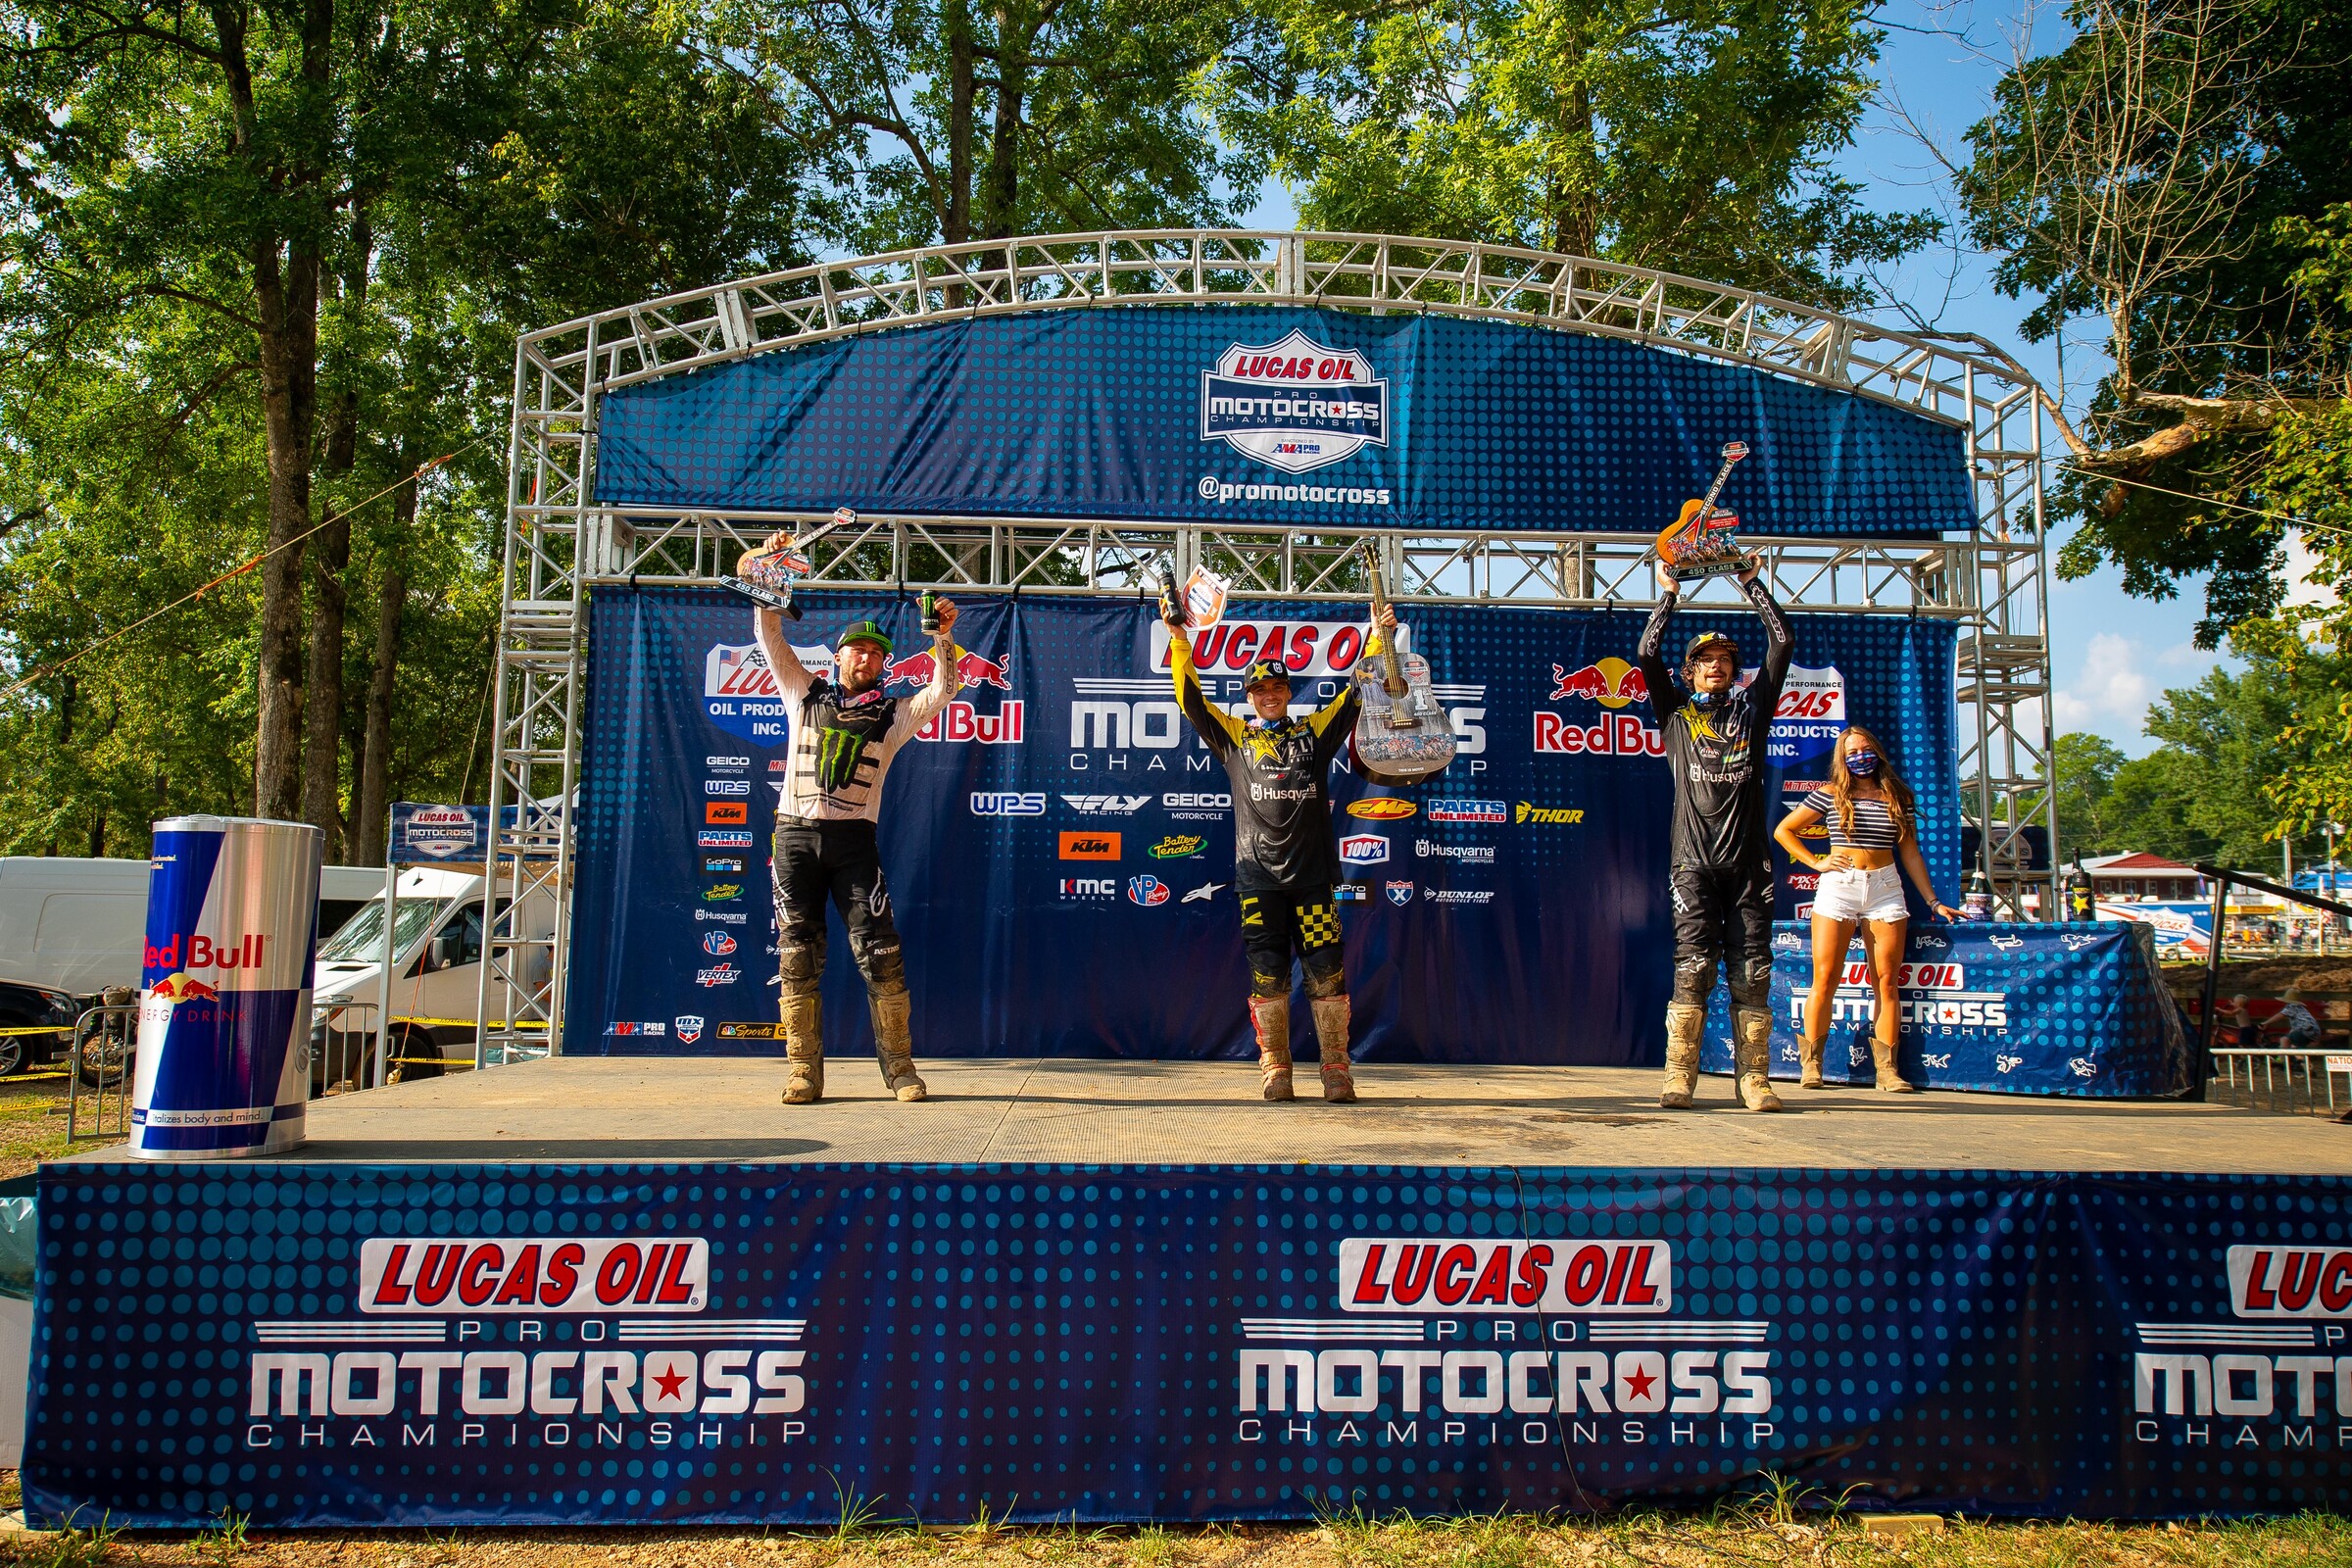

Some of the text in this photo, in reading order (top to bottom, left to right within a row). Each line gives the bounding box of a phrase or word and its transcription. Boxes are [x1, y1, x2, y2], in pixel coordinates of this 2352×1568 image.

[1234, 356, 1355, 380] LUCAS OIL
[1210, 397, 1379, 420] MOTOCROSS
[1210, 416, 1380, 427] CHAMPIONSHIP
[1270, 444, 1303, 454] AMA
[1199, 475, 1390, 505] @promotocross
[1700, 464, 1732, 514] SECOND PLACE
[1708, 564, 1736, 572] CLASS
[735, 582, 775, 602] 450 CLASS
[1227, 680, 1336, 698] PO
[710, 703, 785, 716] OIL PROD
[1773, 690, 1839, 717] CAS
[753, 723, 785, 735] INC.
[946, 701, 1024, 742] Bull
[1534, 712, 1613, 754] Red
[1616, 714, 1669, 758] Bu
[1767, 725, 1840, 738] RODUCTS
[1767, 744, 1799, 757] INC.
[707, 756, 750, 765] GEICO
[1070, 753, 1487, 776] CHAMNIP
[706, 780, 750, 795] WPS
[970, 792, 1046, 816] WPS
[1064, 795, 1152, 810] FLY
[1163, 793, 1232, 808] GEICO
[1429, 799, 1506, 813] PARTS
[418, 812, 465, 822] LUCAS OIL
[711, 808, 741, 817] KTM
[1429, 812, 1506, 822] UNLIMITED
[1531, 808, 1585, 823] THOR
[699, 831, 753, 841] PARTS
[1163, 835, 1201, 847] Battery
[1070, 839, 1109, 854] KTM
[1153, 846, 1195, 859] Tender
[1346, 842, 1383, 858] 100%
[1431, 844, 1495, 858] Husqvarna
[713, 884, 739, 893] Battery
[1060, 879, 1115, 894] KMC
[1128, 874, 1157, 905] VP
[706, 891, 735, 902] Tender
[1394, 889, 1405, 902] X
[1436, 890, 1494, 899] DUNLOP
[706, 911, 747, 921] Husqvarna
[705, 931, 727, 955] VP
[187, 935, 263, 968] Bull
[697, 969, 741, 980] VERTEX
[1917, 964, 1958, 987] OIL
[1866, 990, 1924, 1000] PO
[188, 1009, 247, 1022] DRINK
[603, 1022, 643, 1035] AMA
[735, 1024, 772, 1038] Sports
[184, 1113, 211, 1125] body
[214, 1112, 234, 1122] and
[235, 1110, 264, 1122] mind.
[371, 1242, 698, 1307] LUCAS OIL
[1352, 1244, 1663, 1307] LUCAS OIL
[2243, 1250, 2352, 1313] LUC
[459, 1320, 608, 1343] PRO
[1436, 1319, 1577, 1343] PRO
[250, 1349, 807, 1417] MOTOCROSS
[1239, 1348, 1772, 1413] MOTOCROSS
[2135, 1352, 2352, 1417] MOT
[247, 1421, 806, 1447] CHAMPIONSHIP
[1240, 1419, 1774, 1445] CHAMPIONSHIP
